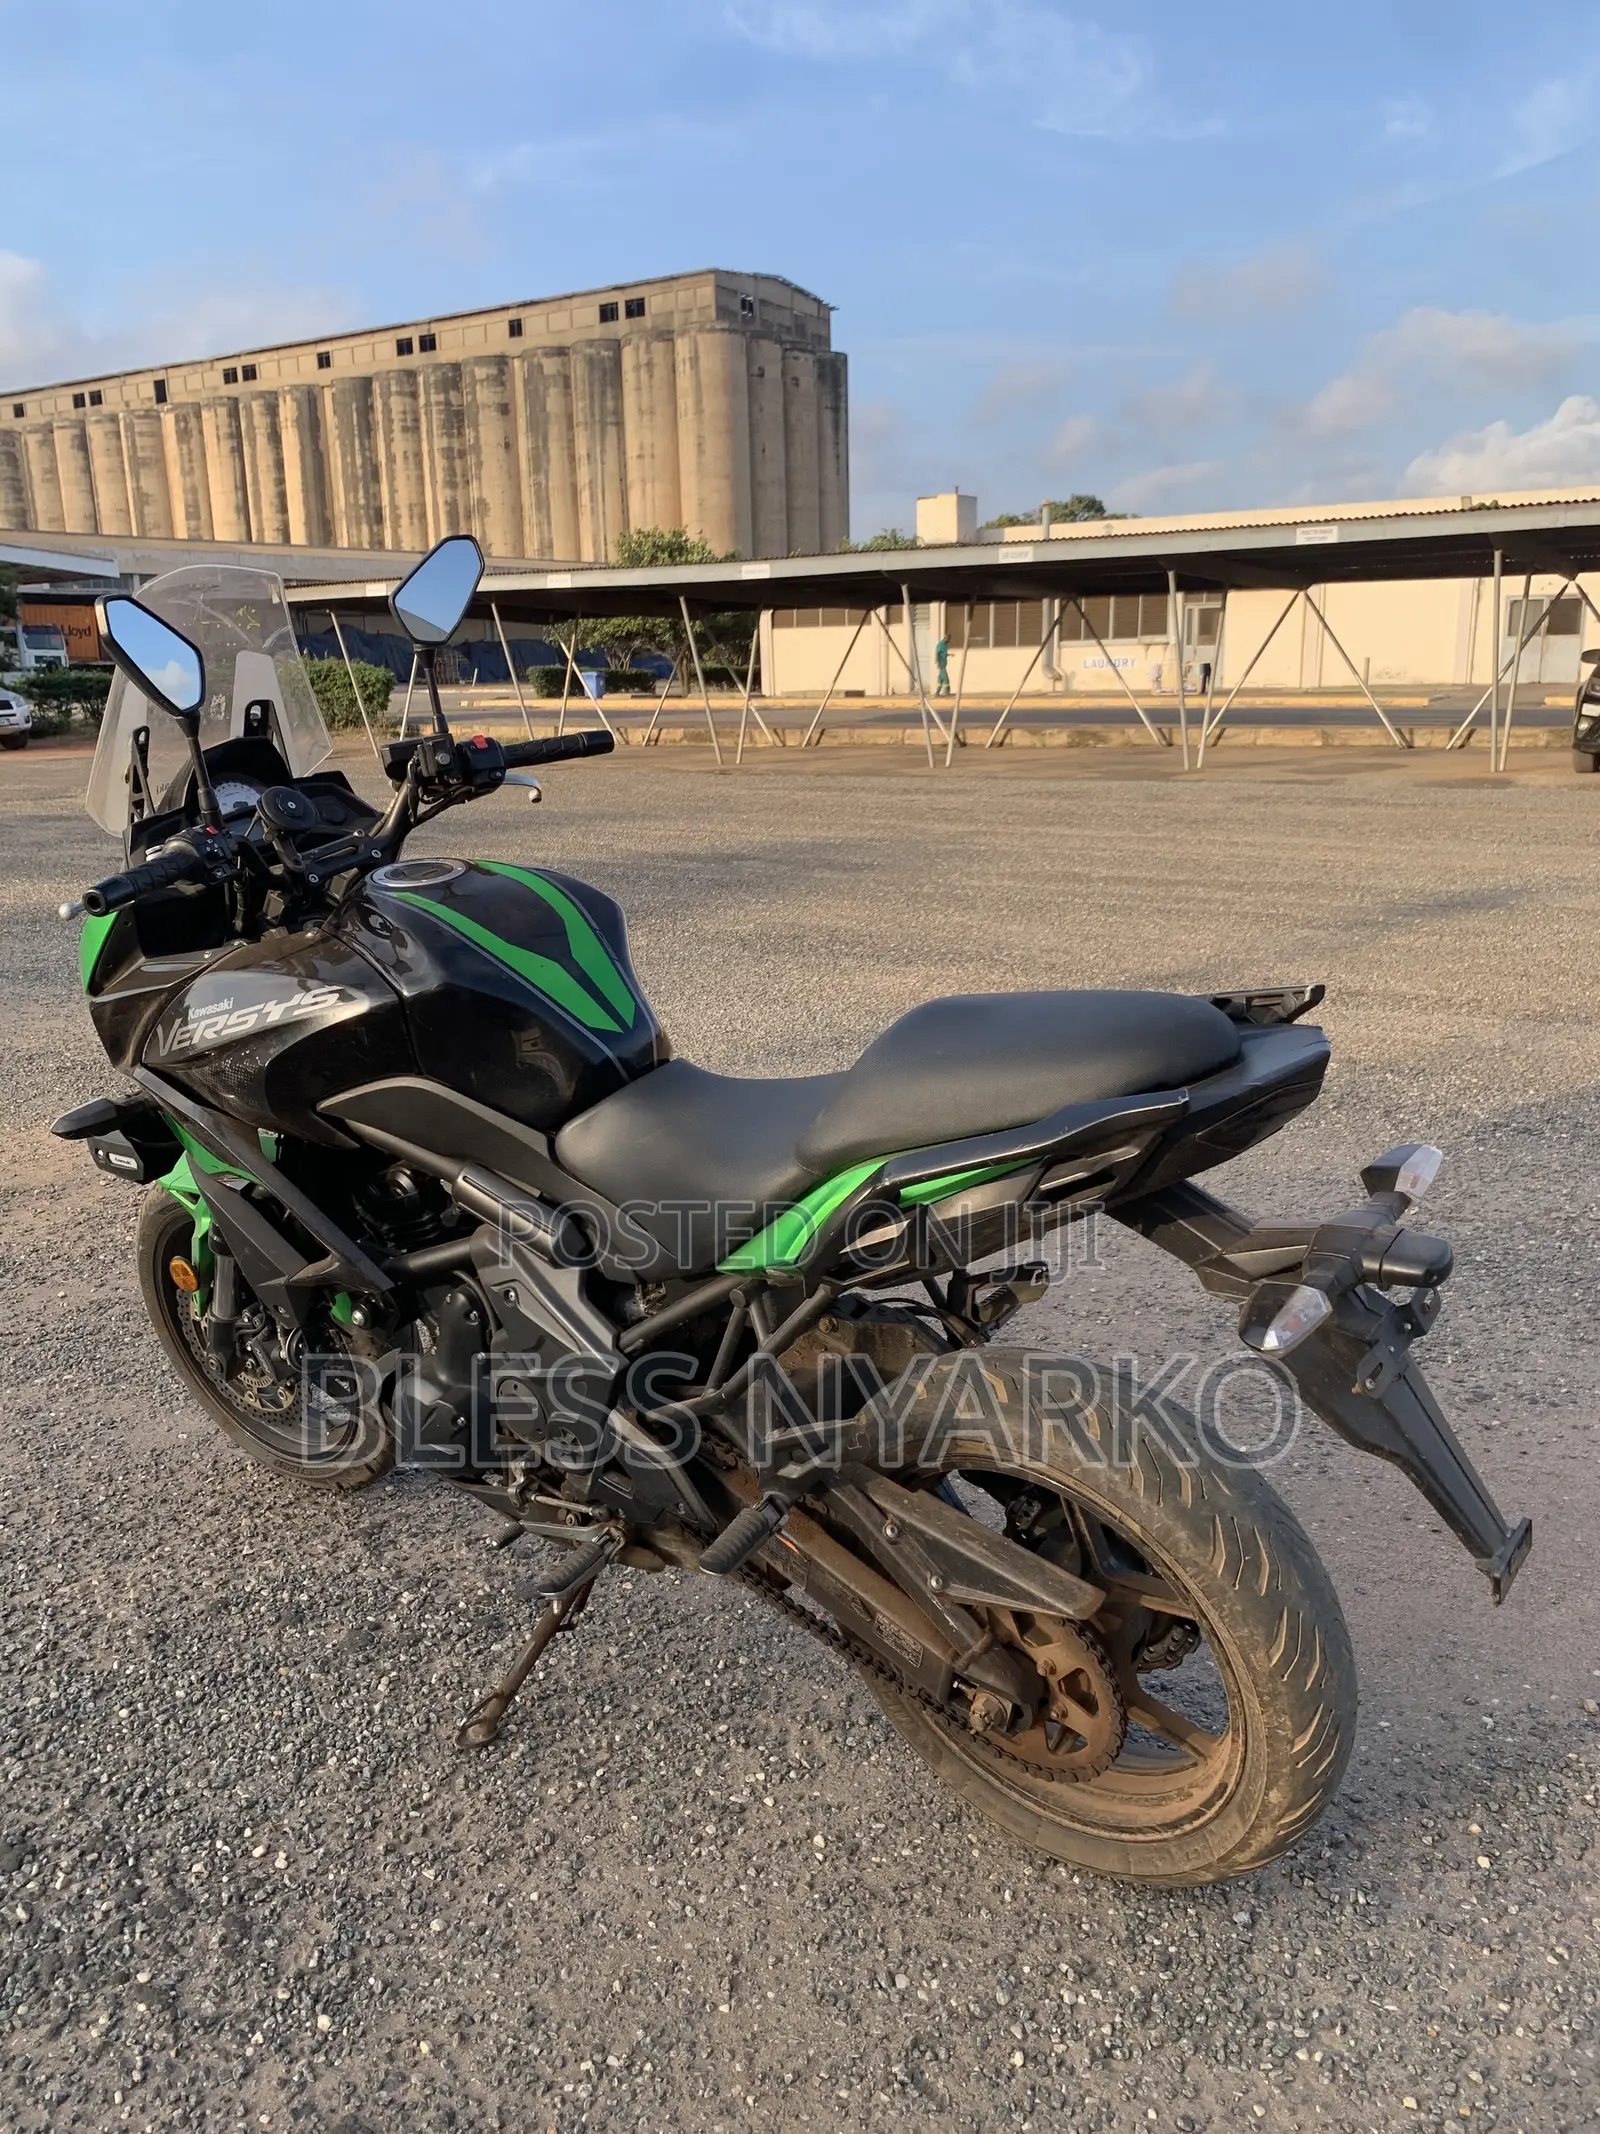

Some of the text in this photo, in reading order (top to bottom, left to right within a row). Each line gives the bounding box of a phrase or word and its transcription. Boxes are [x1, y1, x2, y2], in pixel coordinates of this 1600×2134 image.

[60, 624, 91, 639] Lloyd
[187, 996, 234, 1020] Kawasaki
[156, 985, 345, 1056] VERSYS
